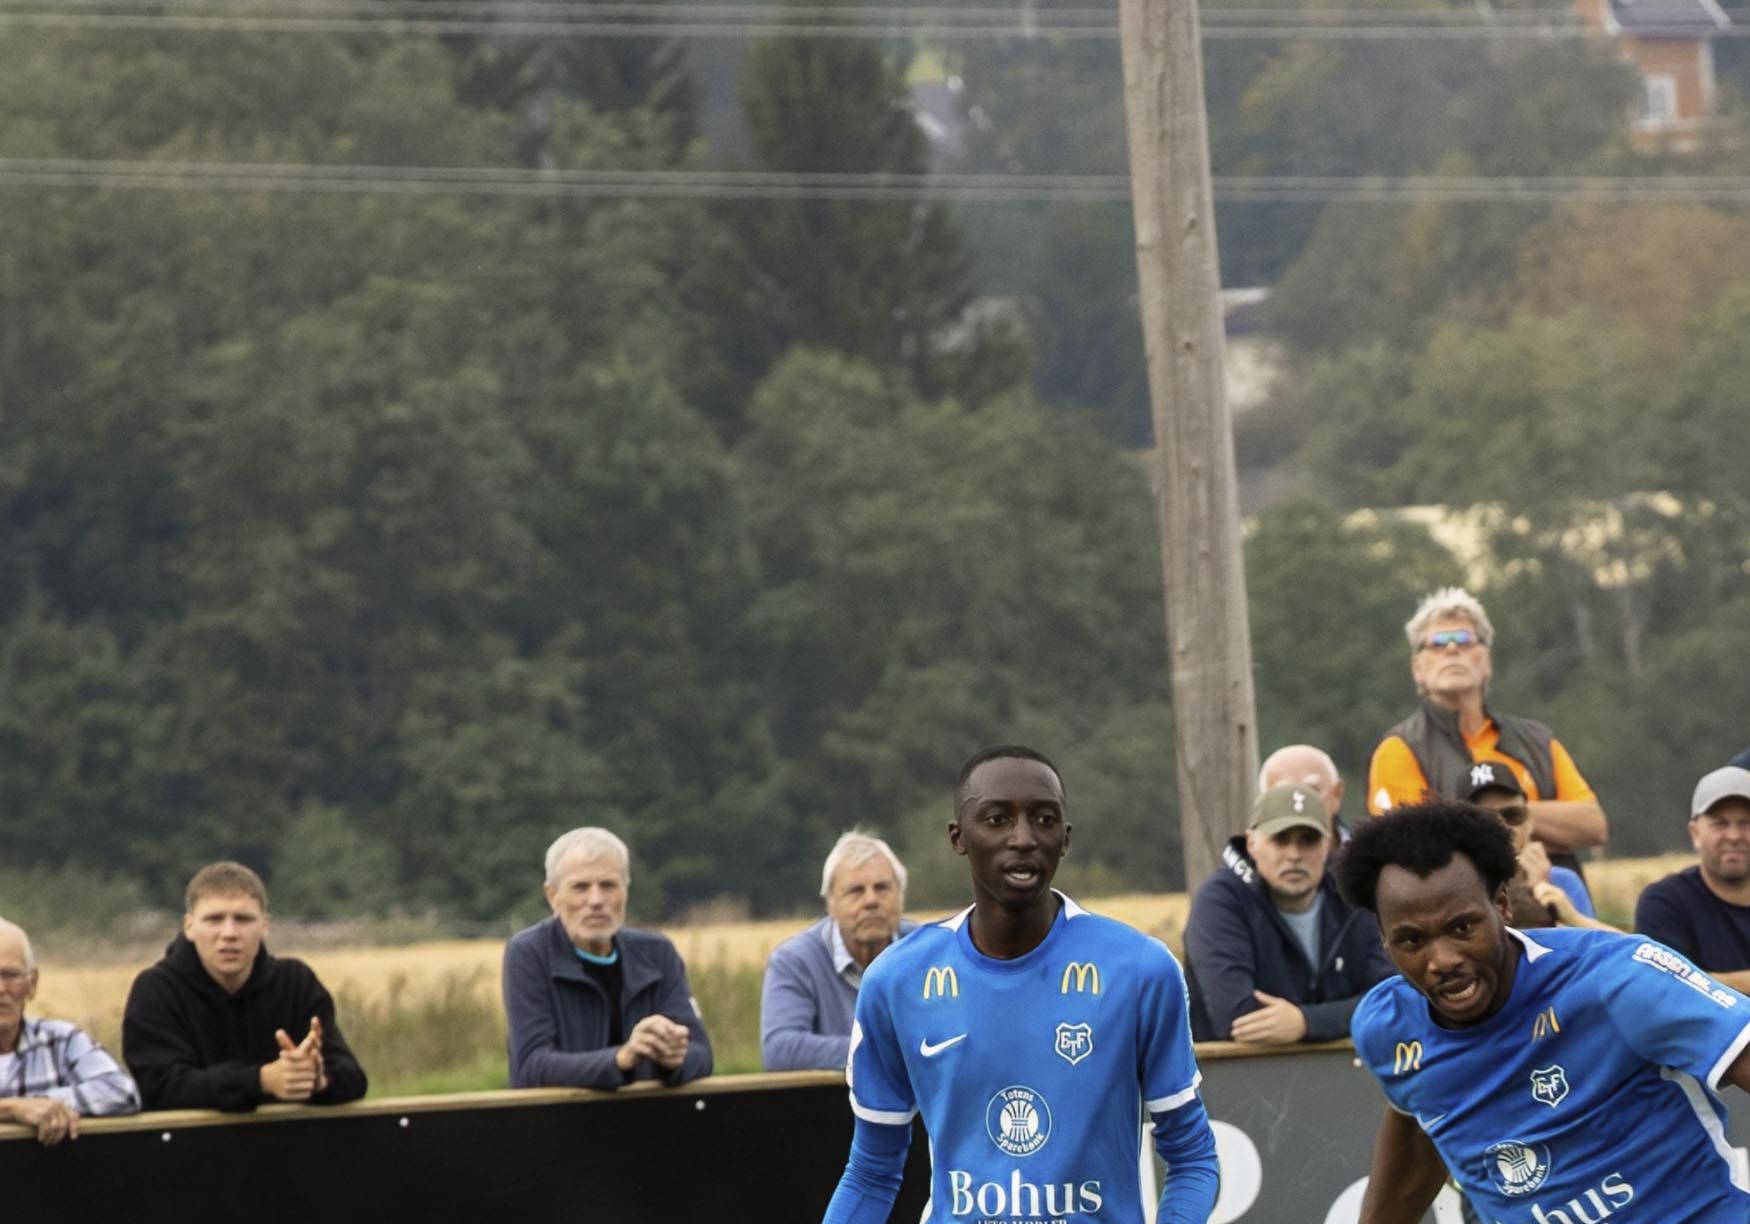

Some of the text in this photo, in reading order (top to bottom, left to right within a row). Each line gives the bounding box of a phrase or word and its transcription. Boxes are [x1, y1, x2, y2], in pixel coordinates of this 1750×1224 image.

[1001, 1089, 1035, 1102] Totens
[996, 1132, 1046, 1154] Sparebank
[948, 1168, 1103, 1217] Bohus
